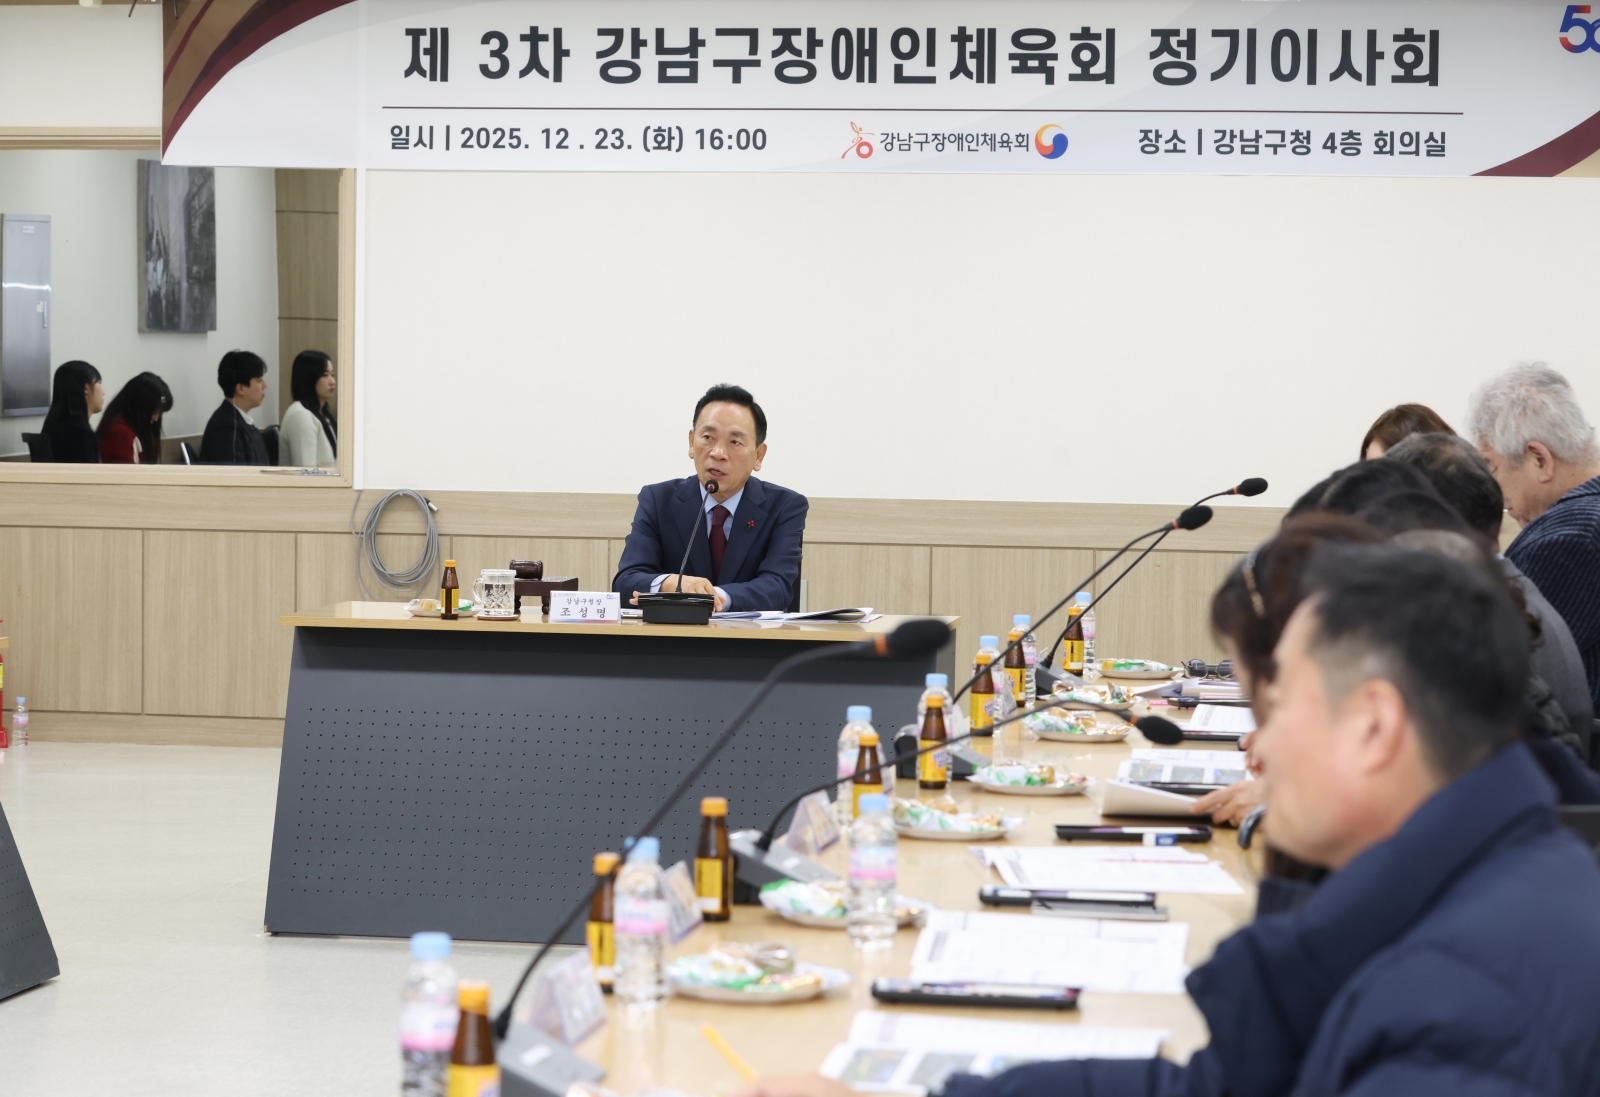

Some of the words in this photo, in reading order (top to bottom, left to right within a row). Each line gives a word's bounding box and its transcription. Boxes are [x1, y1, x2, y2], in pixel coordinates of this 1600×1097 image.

[403, 26, 450, 83] 제
[478, 25, 571, 84] 3차
[595, 26, 1116, 86] 강남구장애인체육회
[1148, 27, 1440, 87] 정기이사회
[390, 124, 434, 150] 일시
[460, 126, 530, 150] 2025.
[594, 127, 633, 150] 23.
[642, 125, 684, 153] (화)
[695, 127, 767, 151] 16:00
[879, 132, 1030, 153] 강남구장애인체육회
[1138, 128, 1187, 155] 장소
[1213, 128, 1312, 156] 강남구청
[1321, 129, 1363, 157] 4층
[1372, 129, 1446, 158] 회의실
